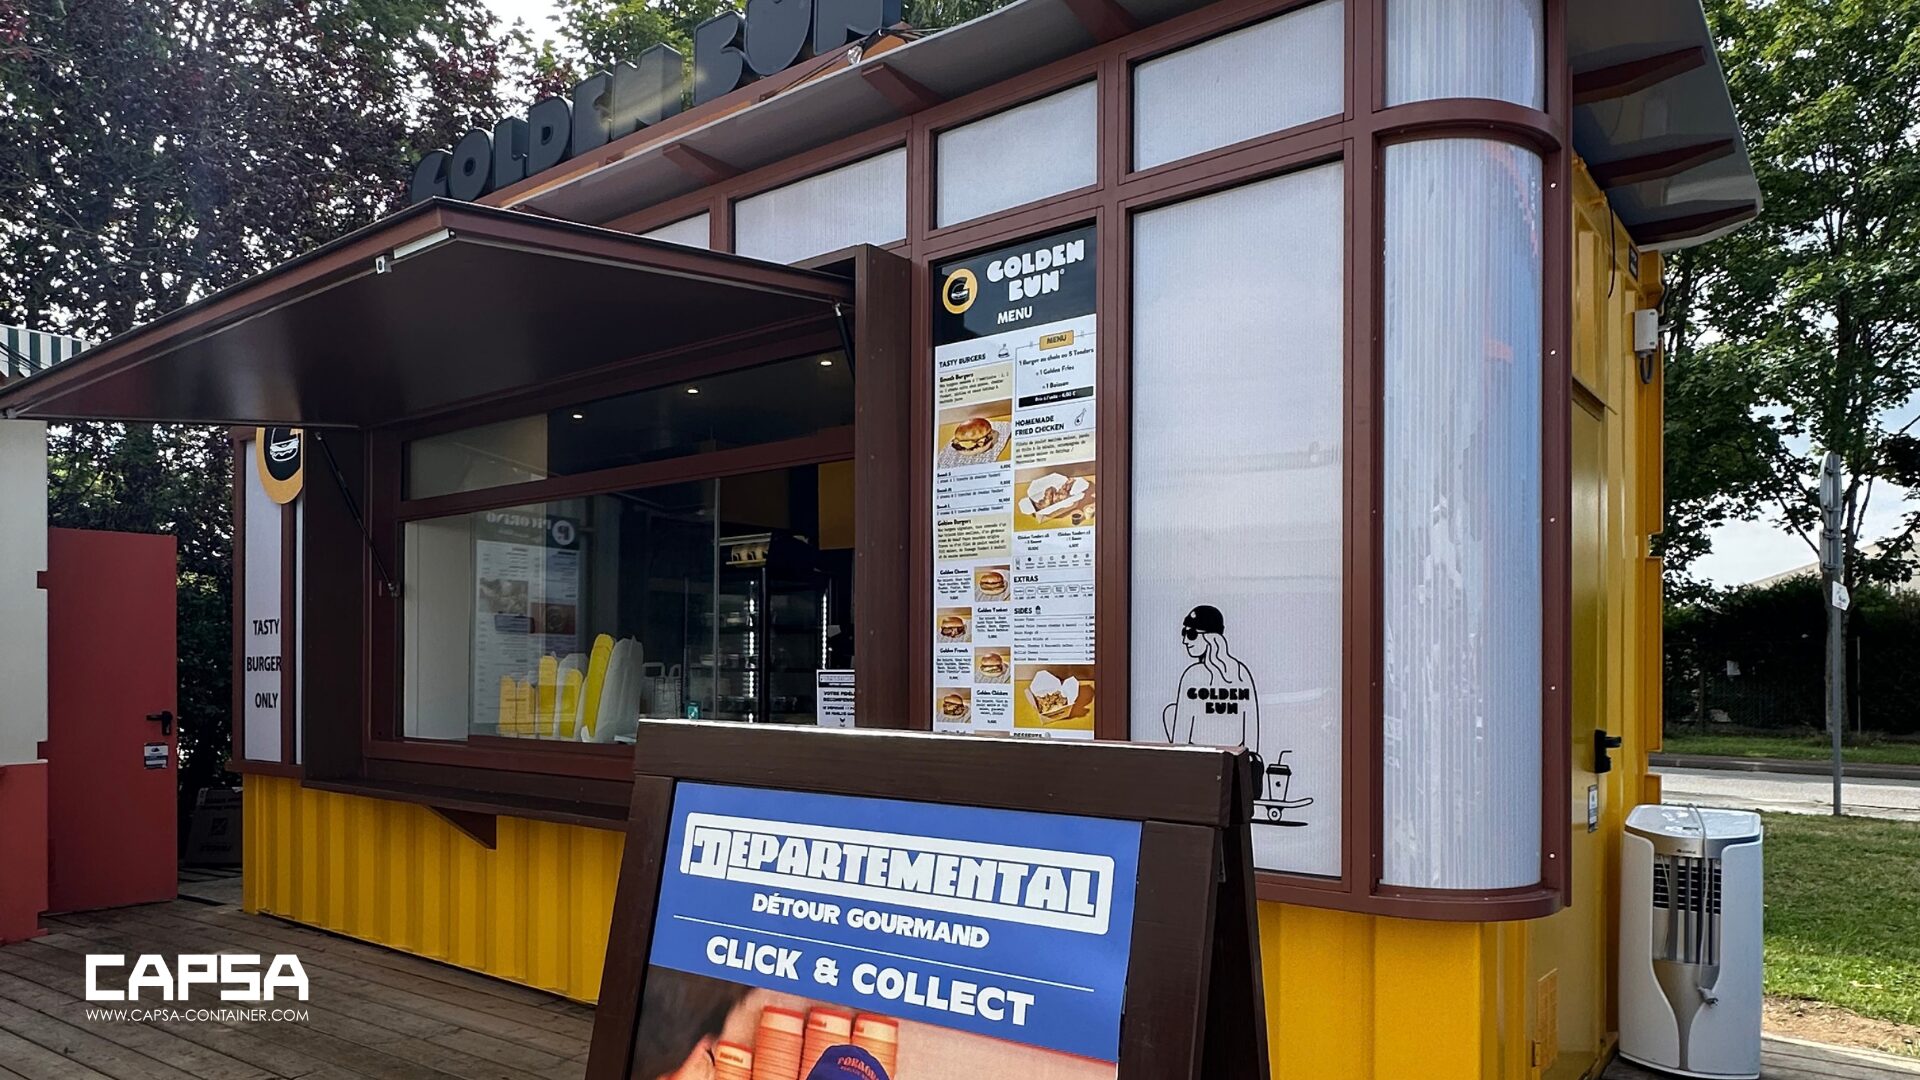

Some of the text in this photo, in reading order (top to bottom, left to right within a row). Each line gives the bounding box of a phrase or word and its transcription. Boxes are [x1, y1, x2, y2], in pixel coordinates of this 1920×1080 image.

[410, 42, 683, 201] GOLDEN
[986, 239, 1085, 283] GOLDEN
[1008, 270, 1060, 302] BUN
[997, 306, 1033, 325] MENU
[1046, 334, 1067, 345] MENU
[939, 353, 986, 368] TASTY BURGERS
[1015, 415, 1055, 427] HOMEMADE
[1015, 423, 1065, 436] FRIED CHICKEN
[1013, 575, 1039, 583] EXTRAS
[1014, 607, 1033, 615] SIDES
[252, 618, 280, 636] TASTY
[246, 655, 282, 673] BURGER
[254, 692, 279, 710] ONLY
[1186, 687, 1250, 701] GOLDEN
[1205, 702, 1239, 715] BUN
[688, 825, 1097, 917] DEPARTEMENTAL
[751, 892, 991, 950] DÉTOUR GOURMAND
[705, 935, 1036, 1026] CLICK & COLLECT
